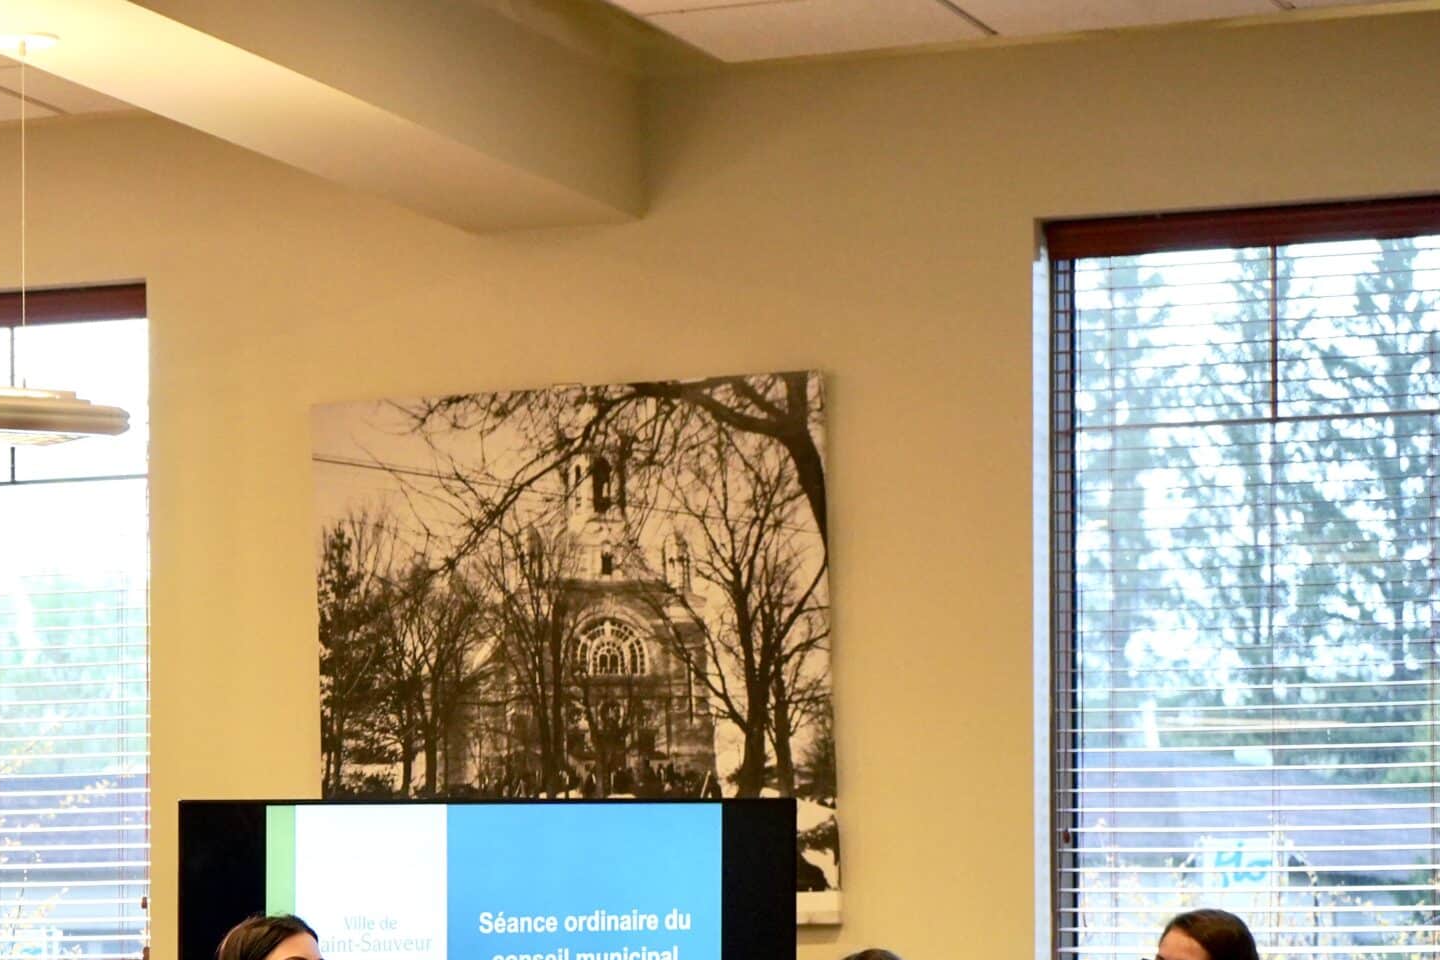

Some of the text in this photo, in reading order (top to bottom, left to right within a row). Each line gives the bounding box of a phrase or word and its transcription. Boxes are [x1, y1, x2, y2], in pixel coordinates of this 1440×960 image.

[343, 915, 398, 931] Ville de
[478, 908, 692, 934] Séance ordinaire du
[319, 932, 433, 953] aint-Sauveur
